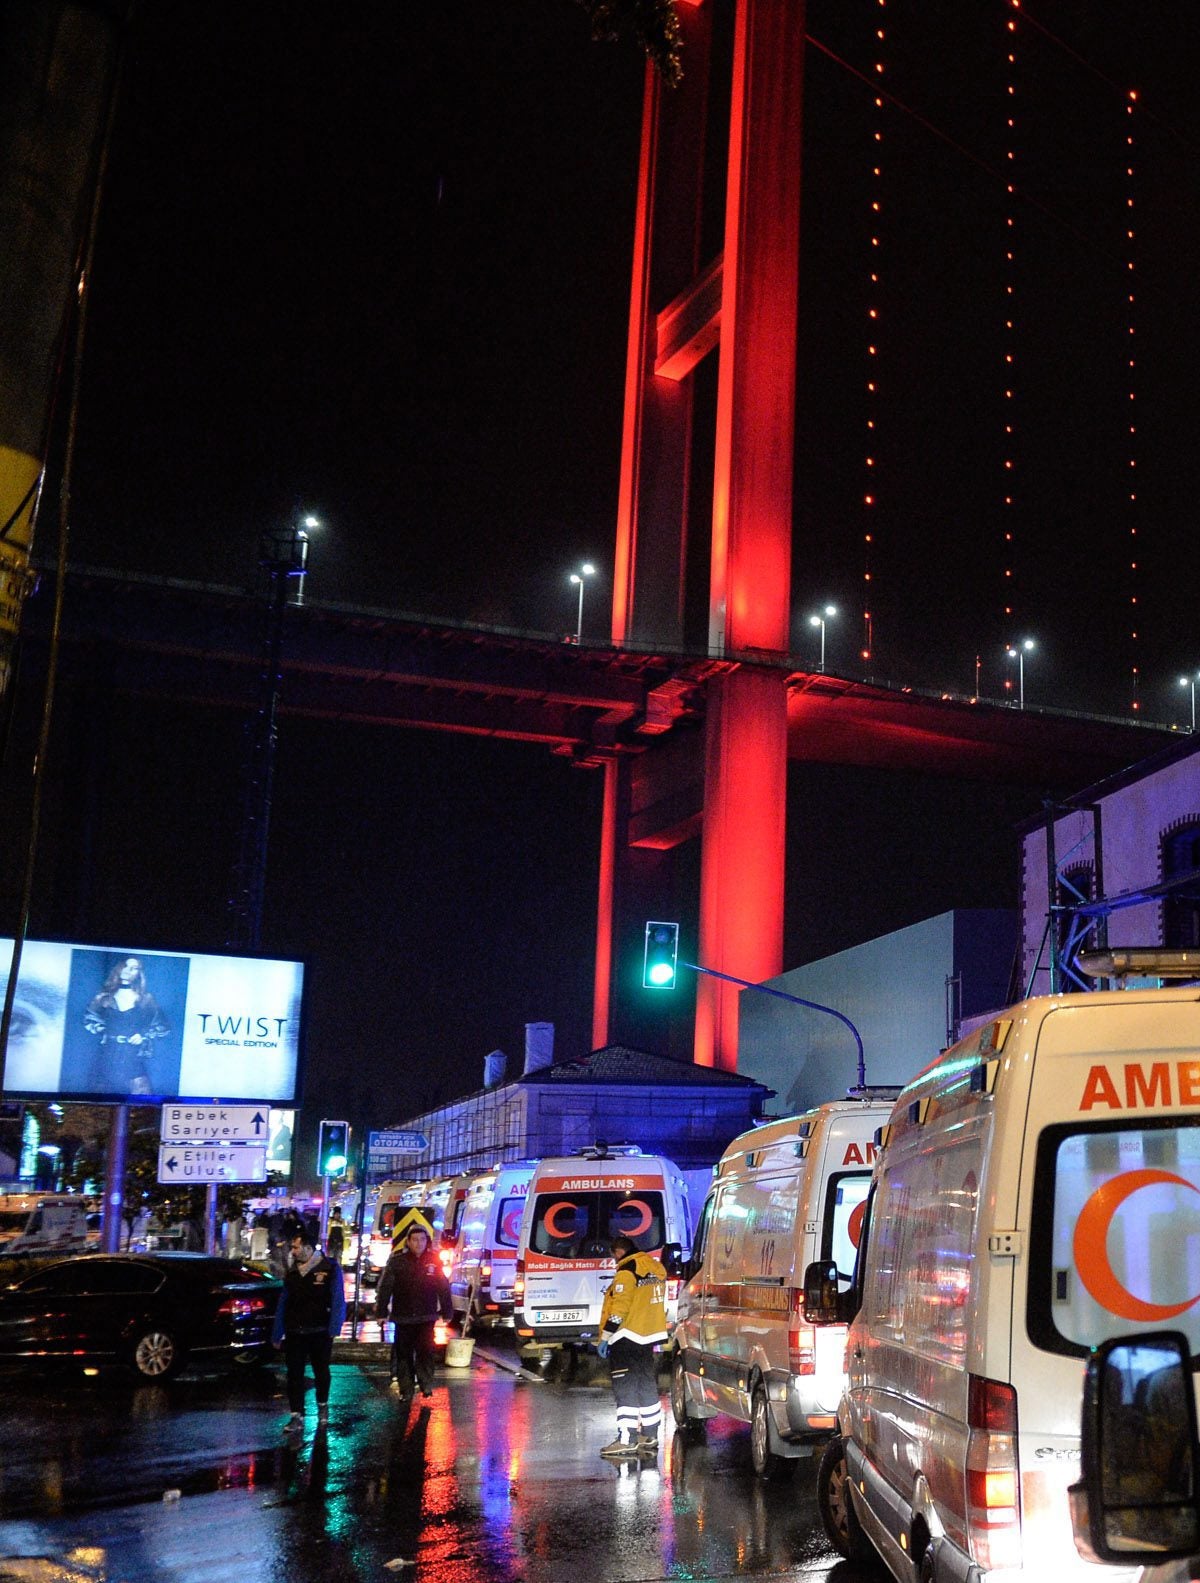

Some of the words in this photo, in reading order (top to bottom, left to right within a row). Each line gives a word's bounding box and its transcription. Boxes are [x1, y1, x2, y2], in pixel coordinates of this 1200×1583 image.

[197, 1013, 287, 1037] TWIST
[205, 1038, 240, 1046] SPECIAL
[243, 1040, 277, 1048] EDITION
[172, 1110, 227, 1120] Bebek
[171, 1125, 239, 1137] Sarıyer
[184, 1151, 235, 1161] Etiler
[184, 1166, 224, 1175] Ulus
[561, 1179, 634, 1190] AMBULANS
[528, 1262, 548, 1270] Mobil
[550, 1262, 574, 1271] Sağlık
